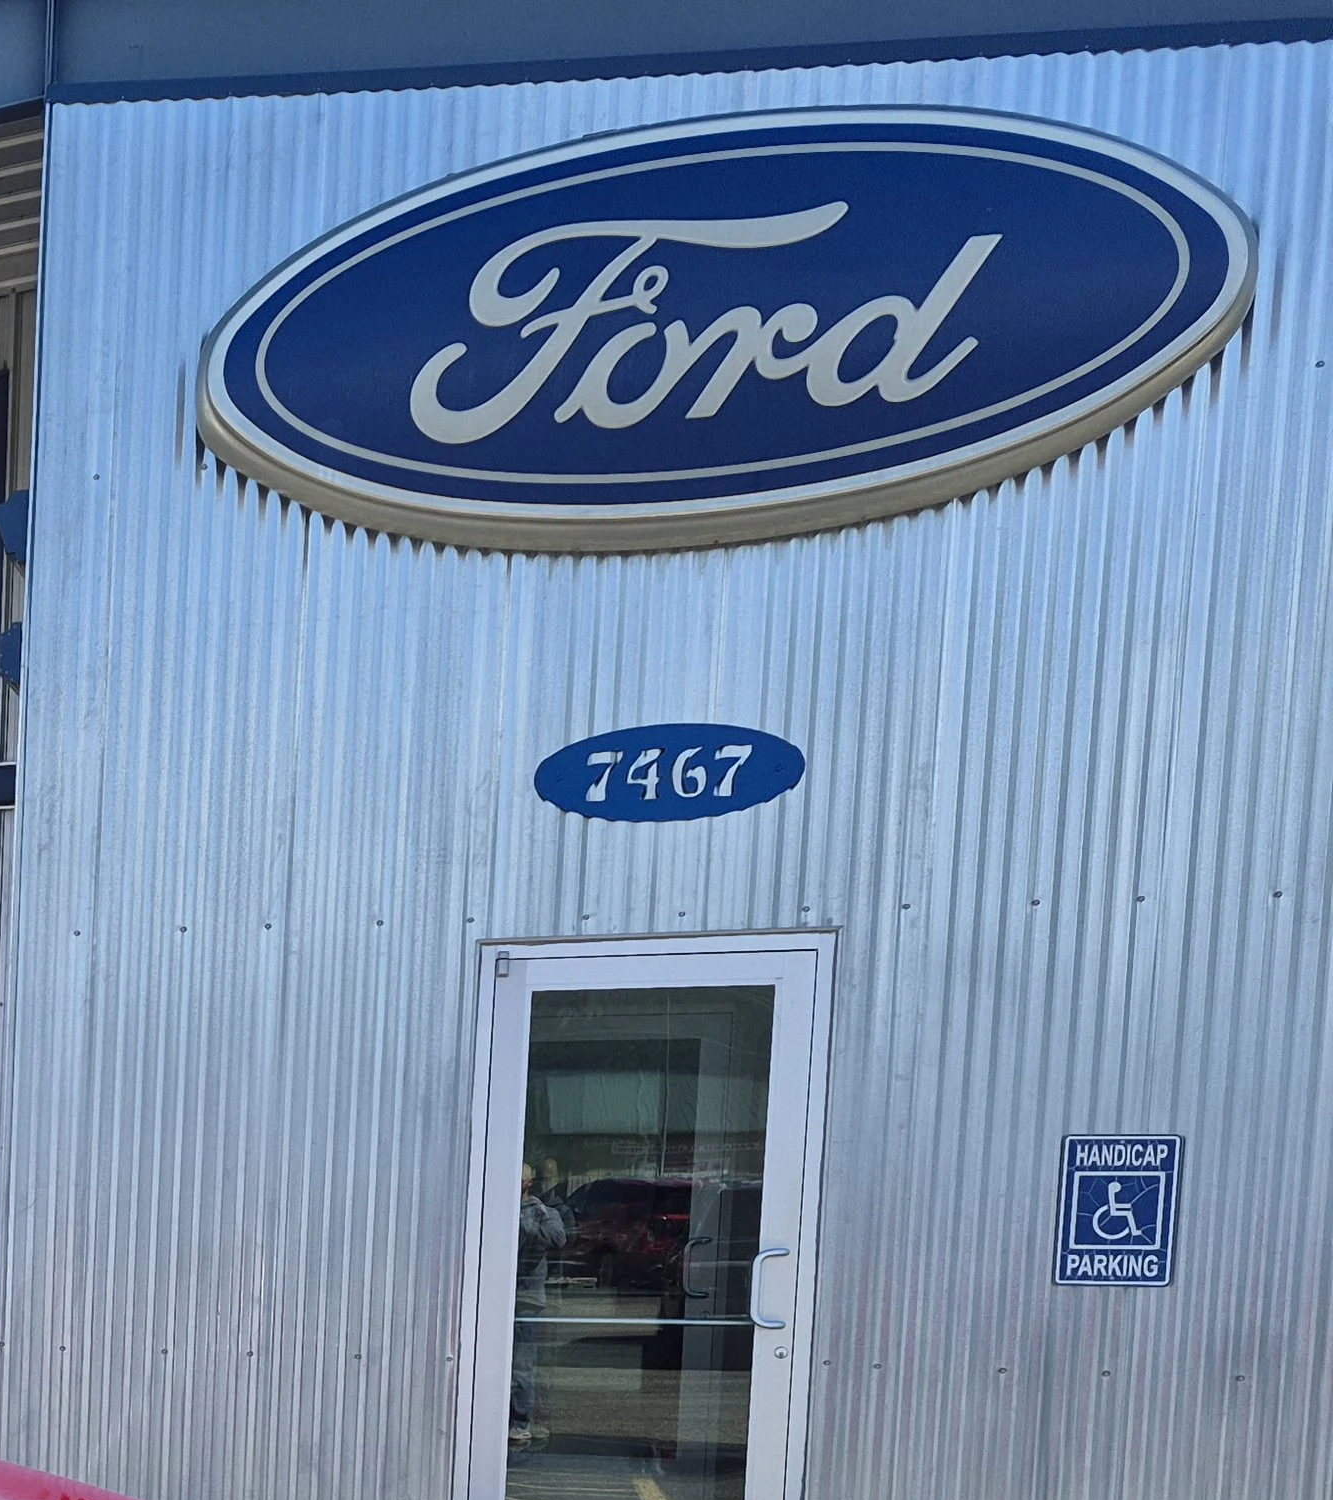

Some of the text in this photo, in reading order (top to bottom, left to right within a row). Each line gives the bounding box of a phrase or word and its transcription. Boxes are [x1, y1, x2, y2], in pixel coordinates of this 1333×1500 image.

[409, 199, 1001, 444] Ford
[585, 744, 753, 802] 7467
[1075, 1143, 1169, 1167] HANDICAP
[1066, 1254, 1160, 1278] PARKING
